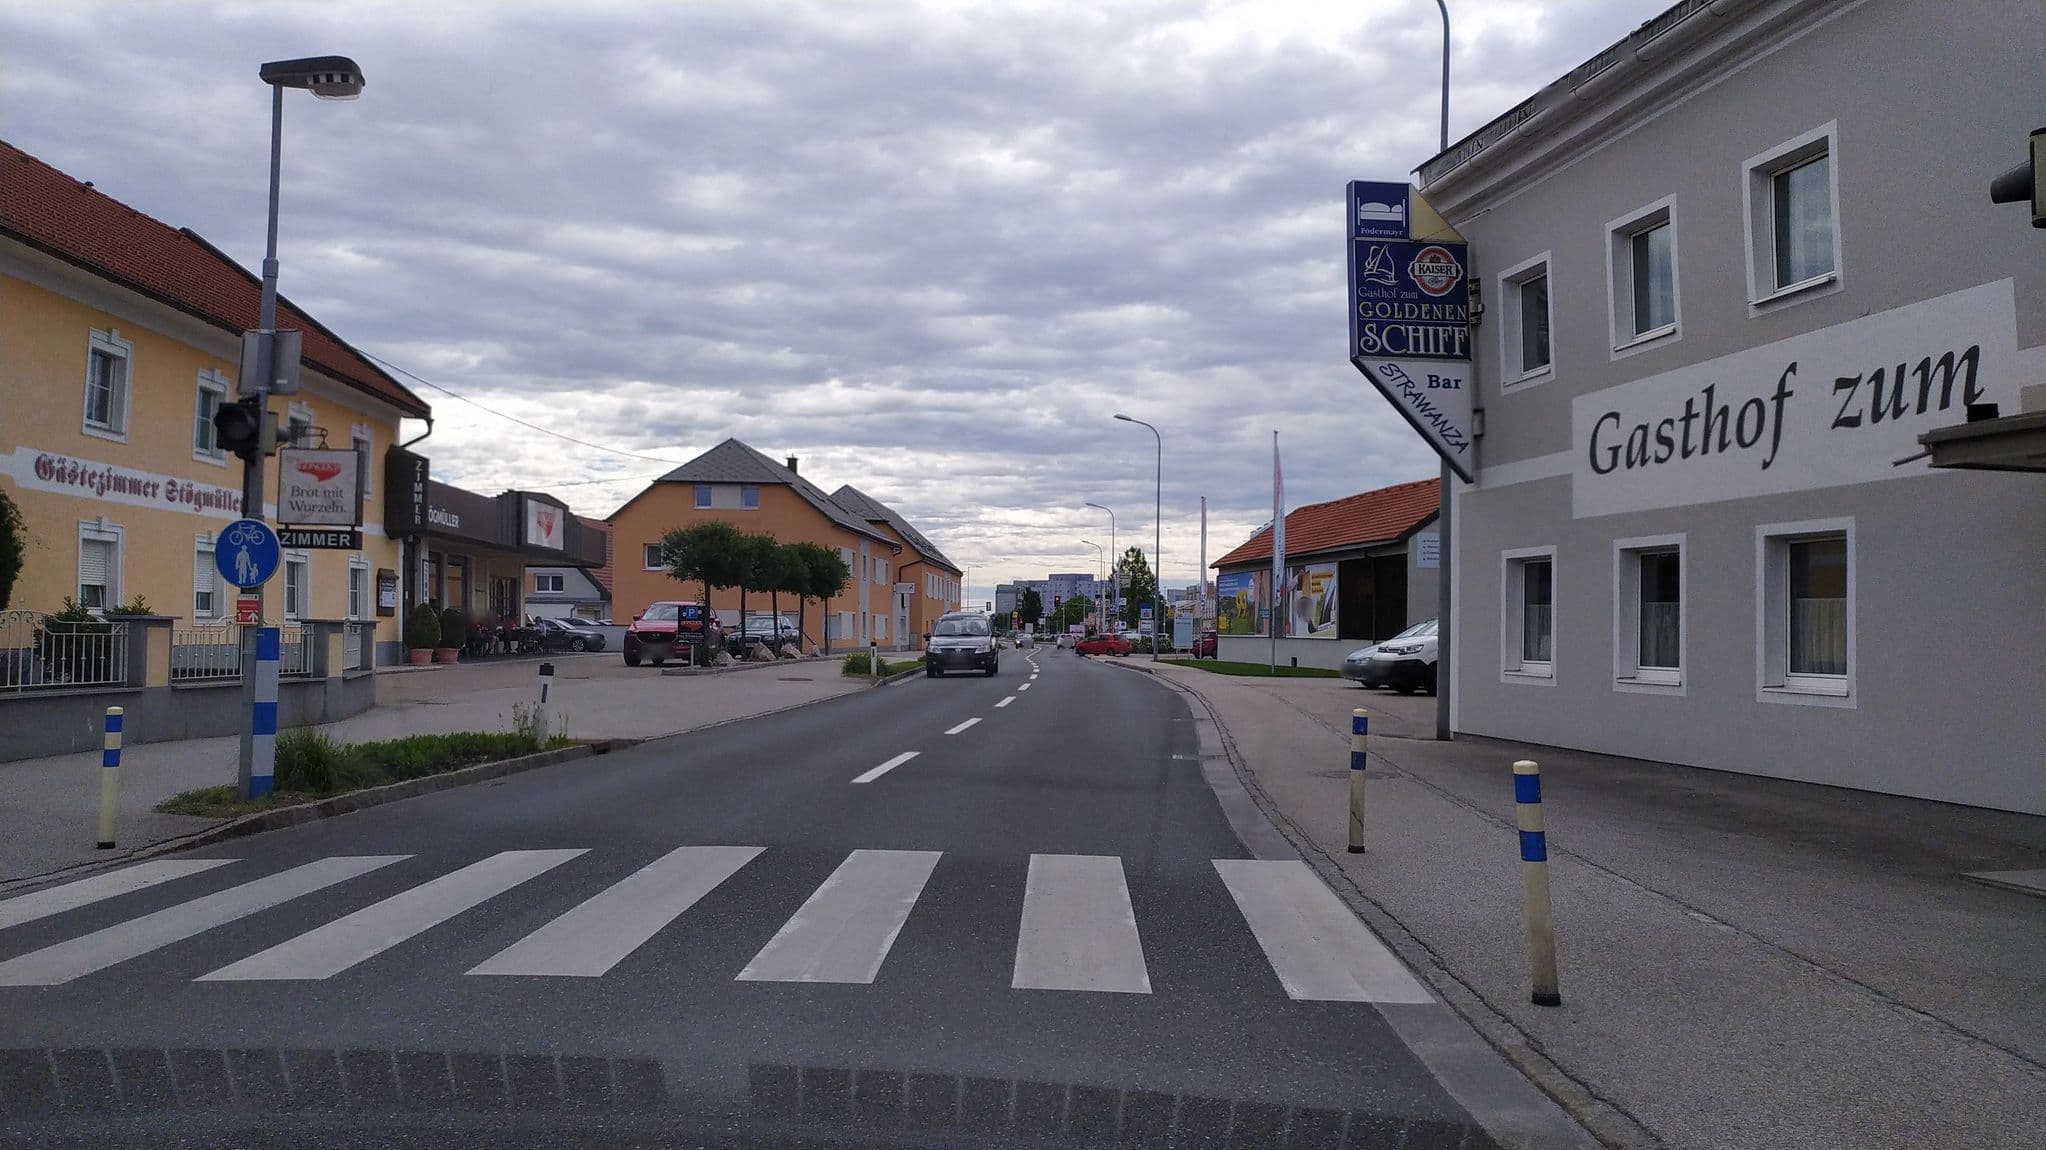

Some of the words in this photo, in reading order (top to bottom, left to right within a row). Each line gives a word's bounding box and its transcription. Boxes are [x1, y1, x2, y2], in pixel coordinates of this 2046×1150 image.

[1419, 264, 1453, 275] KAISER
[1358, 287, 1398, 299] Gasthof
[1401, 290, 1418, 299] zum
[1359, 301, 1467, 320] GOLDENEN
[1360, 322, 1469, 356] SCHIFF
[1427, 374, 1462, 389] Bar
[1378, 363, 1469, 454] STRAWANZA
[1589, 361, 1798, 475] Gasthof
[1830, 344, 1985, 430] zum
[34, 453, 160, 498] Gästezimmer
[291, 485, 319, 498] Brot
[323, 486, 344, 498] mit
[414, 460, 423, 525] ZIMMER
[289, 500, 346, 513] Wurzeln.
[428, 504, 460, 529] ÖGMÜLLER
[280, 532, 351, 547] ZIMMER
